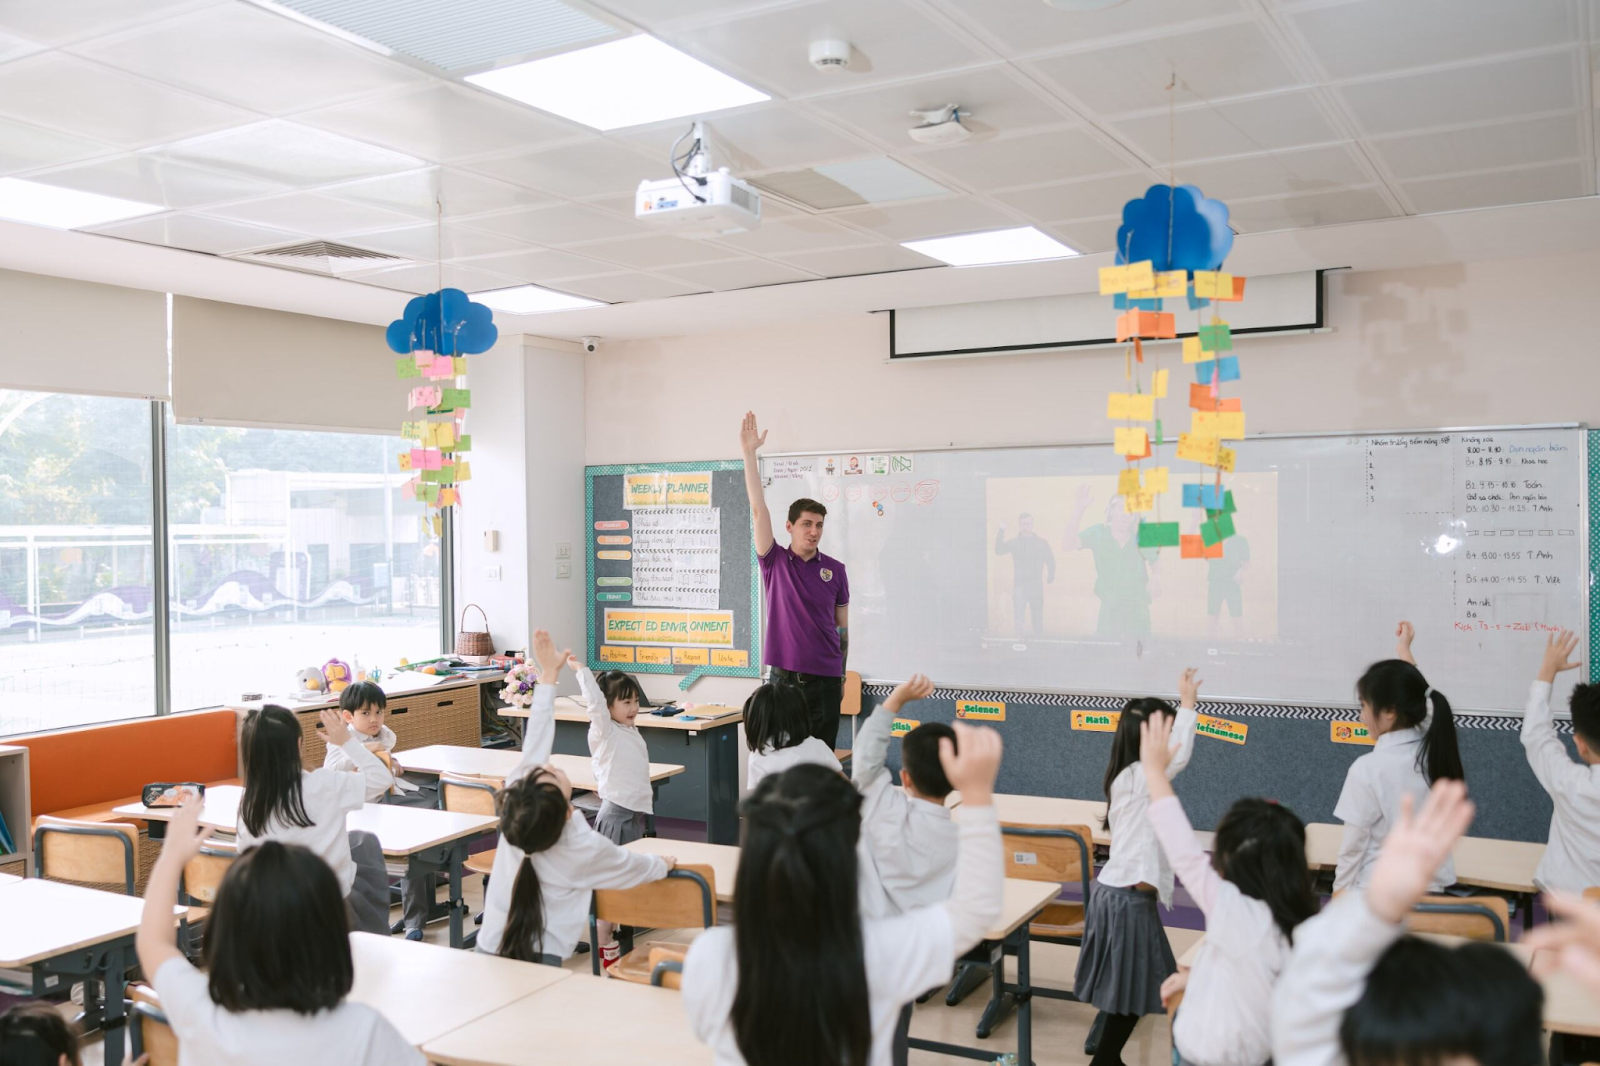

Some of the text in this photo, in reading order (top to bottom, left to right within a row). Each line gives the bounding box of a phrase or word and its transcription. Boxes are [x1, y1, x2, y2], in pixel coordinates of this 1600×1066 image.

[631, 483, 709, 494] WEEKLY PLANNER
[964, 704, 1000, 715] Science
[1085, 716, 1110, 724] Math
